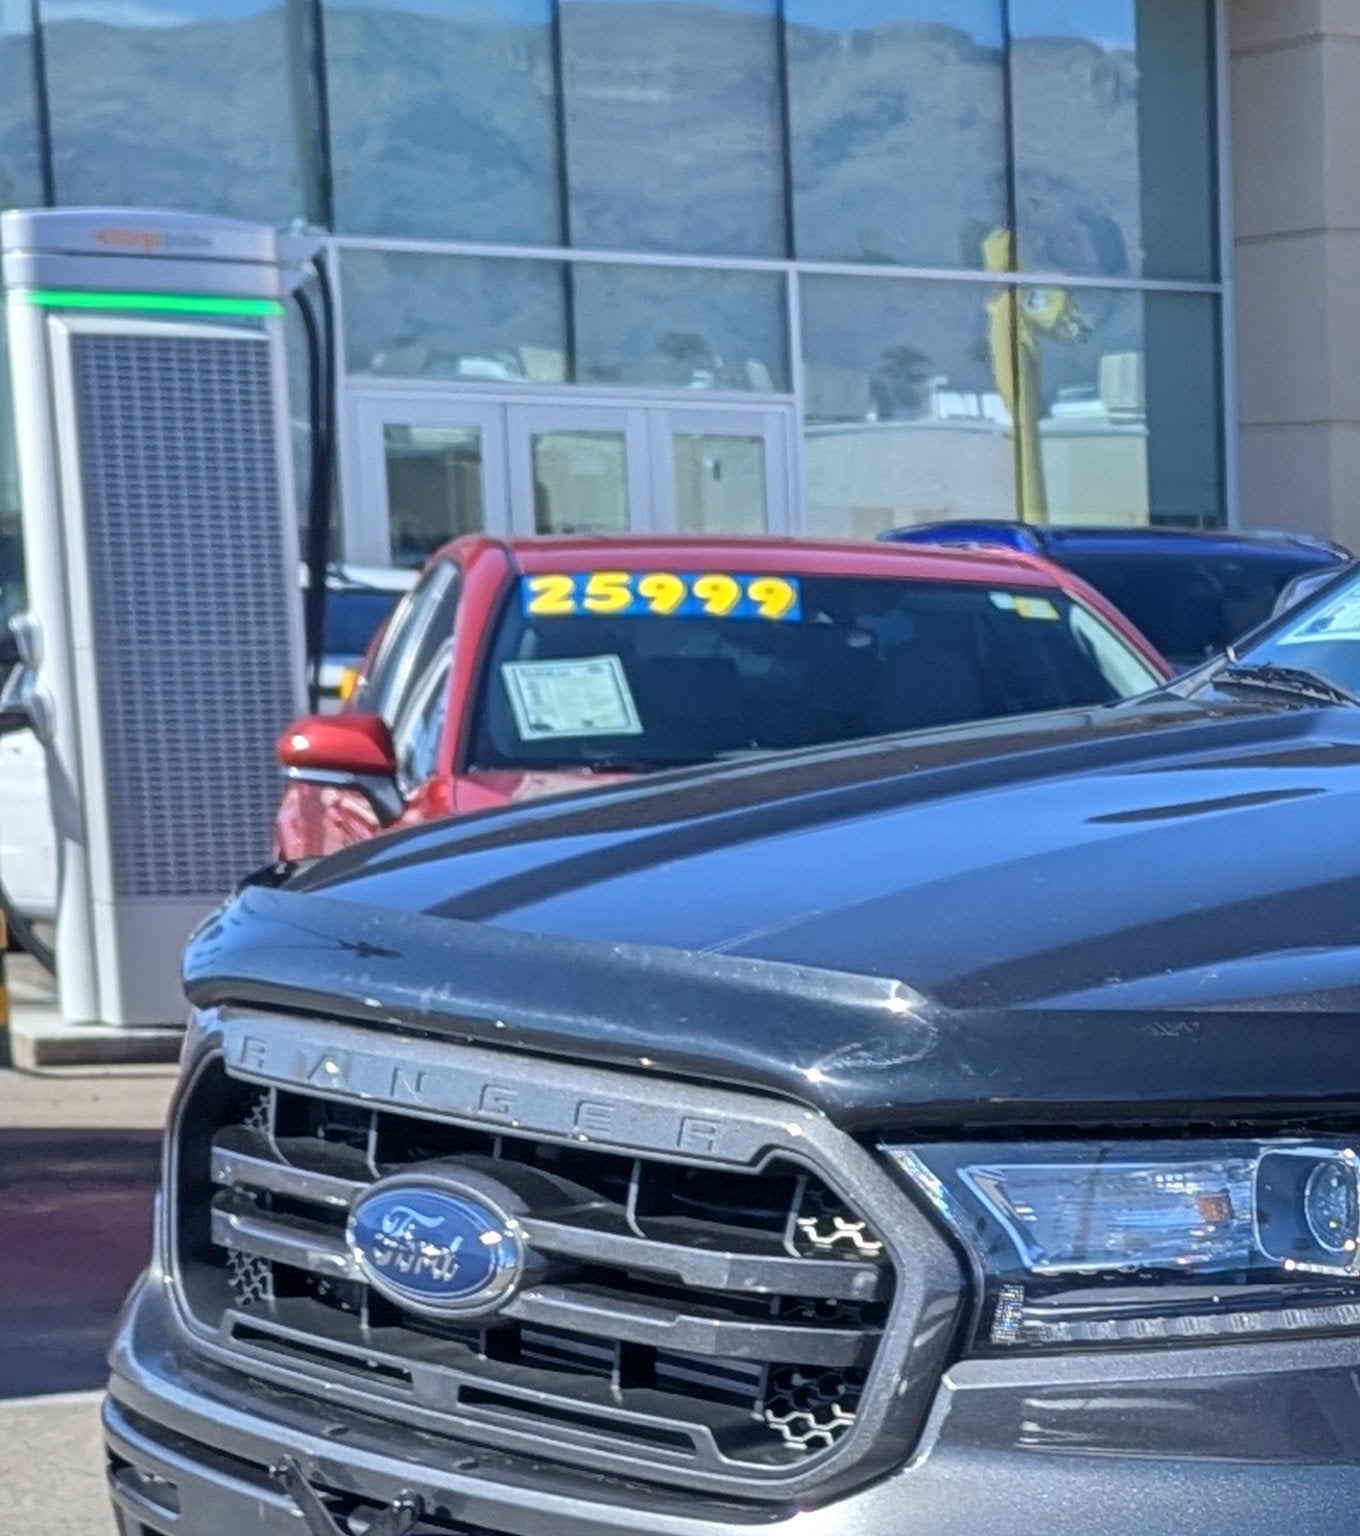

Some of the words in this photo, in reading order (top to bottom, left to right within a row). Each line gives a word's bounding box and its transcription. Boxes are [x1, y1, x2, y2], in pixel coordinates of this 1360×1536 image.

[528, 573, 796, 618] 25999
[241, 1035, 722, 1153] RANGER
[374, 1206, 464, 1282] Ford
